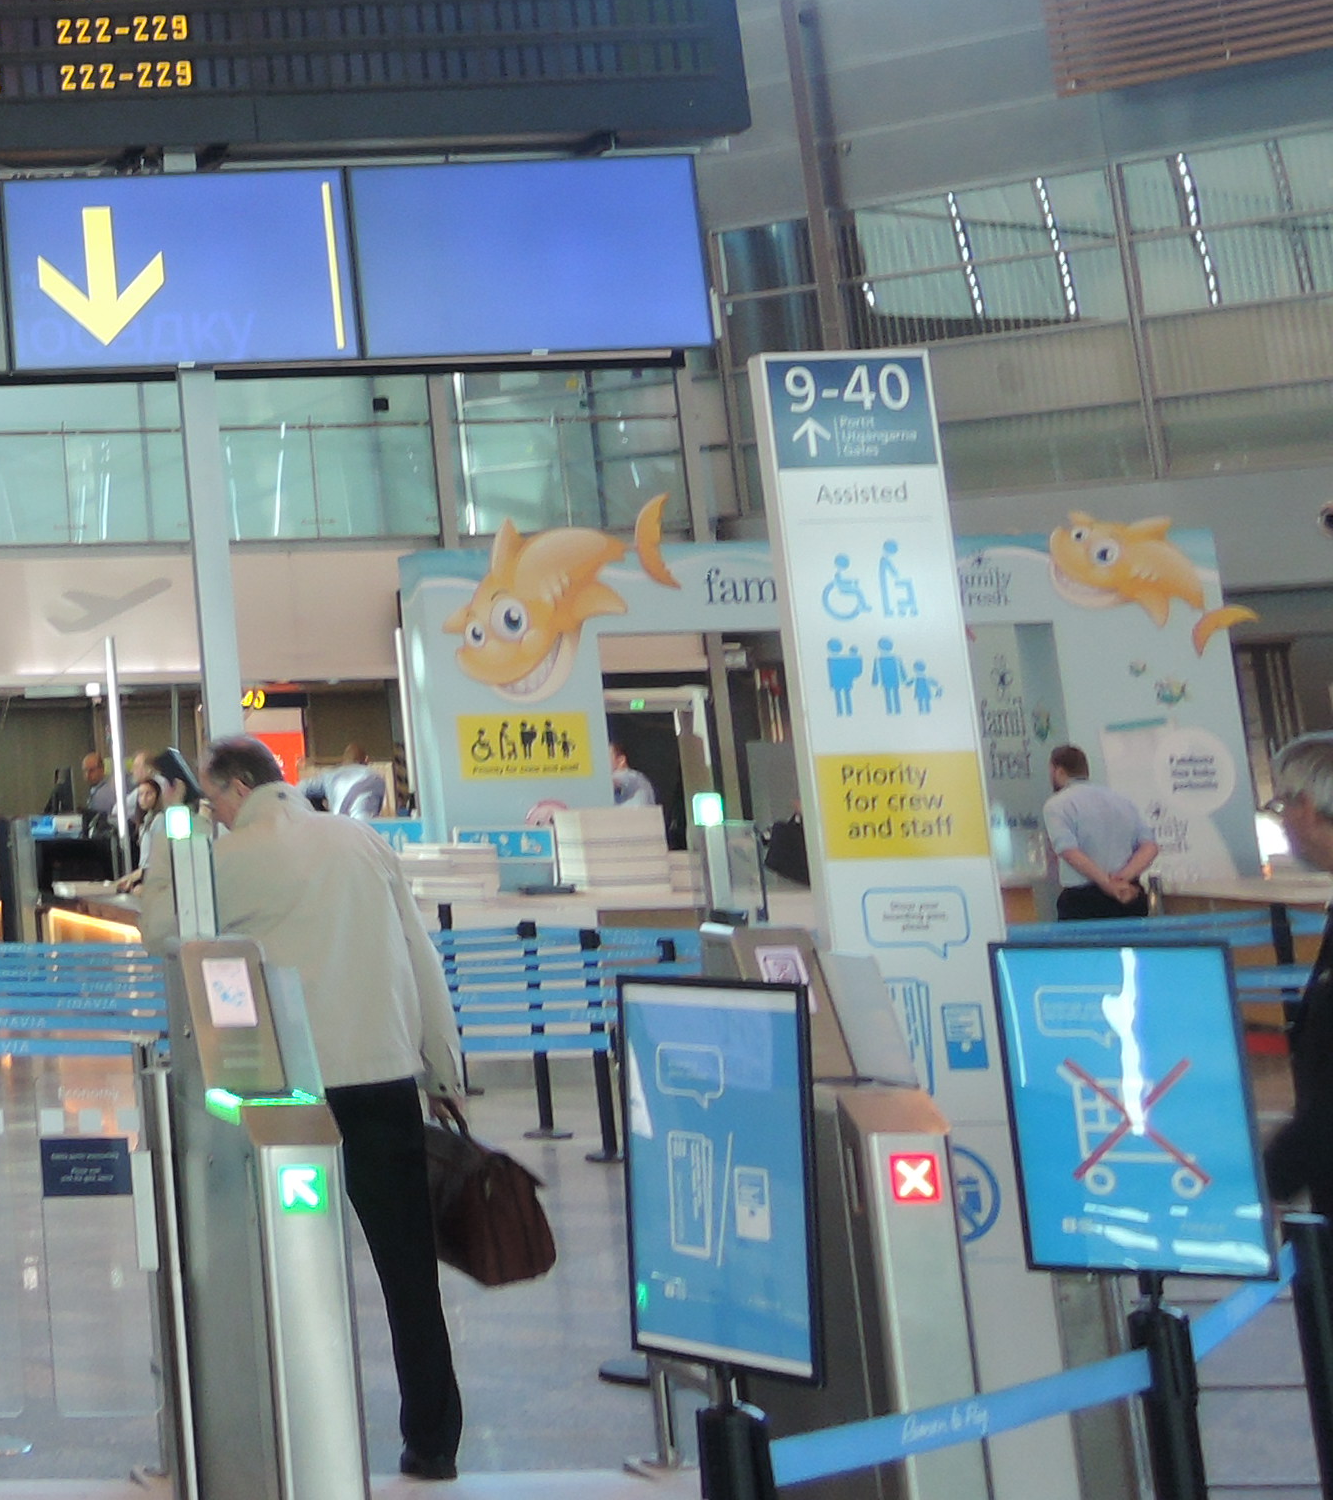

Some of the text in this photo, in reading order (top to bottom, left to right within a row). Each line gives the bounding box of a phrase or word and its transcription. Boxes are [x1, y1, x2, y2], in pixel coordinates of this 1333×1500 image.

[785, 365, 909, 413] 9-40
[816, 483, 909, 505] Assisted
[841, 765, 928, 789] Priority
[845, 791, 944, 812] for crew
[848, 815, 954, 839] and staff
